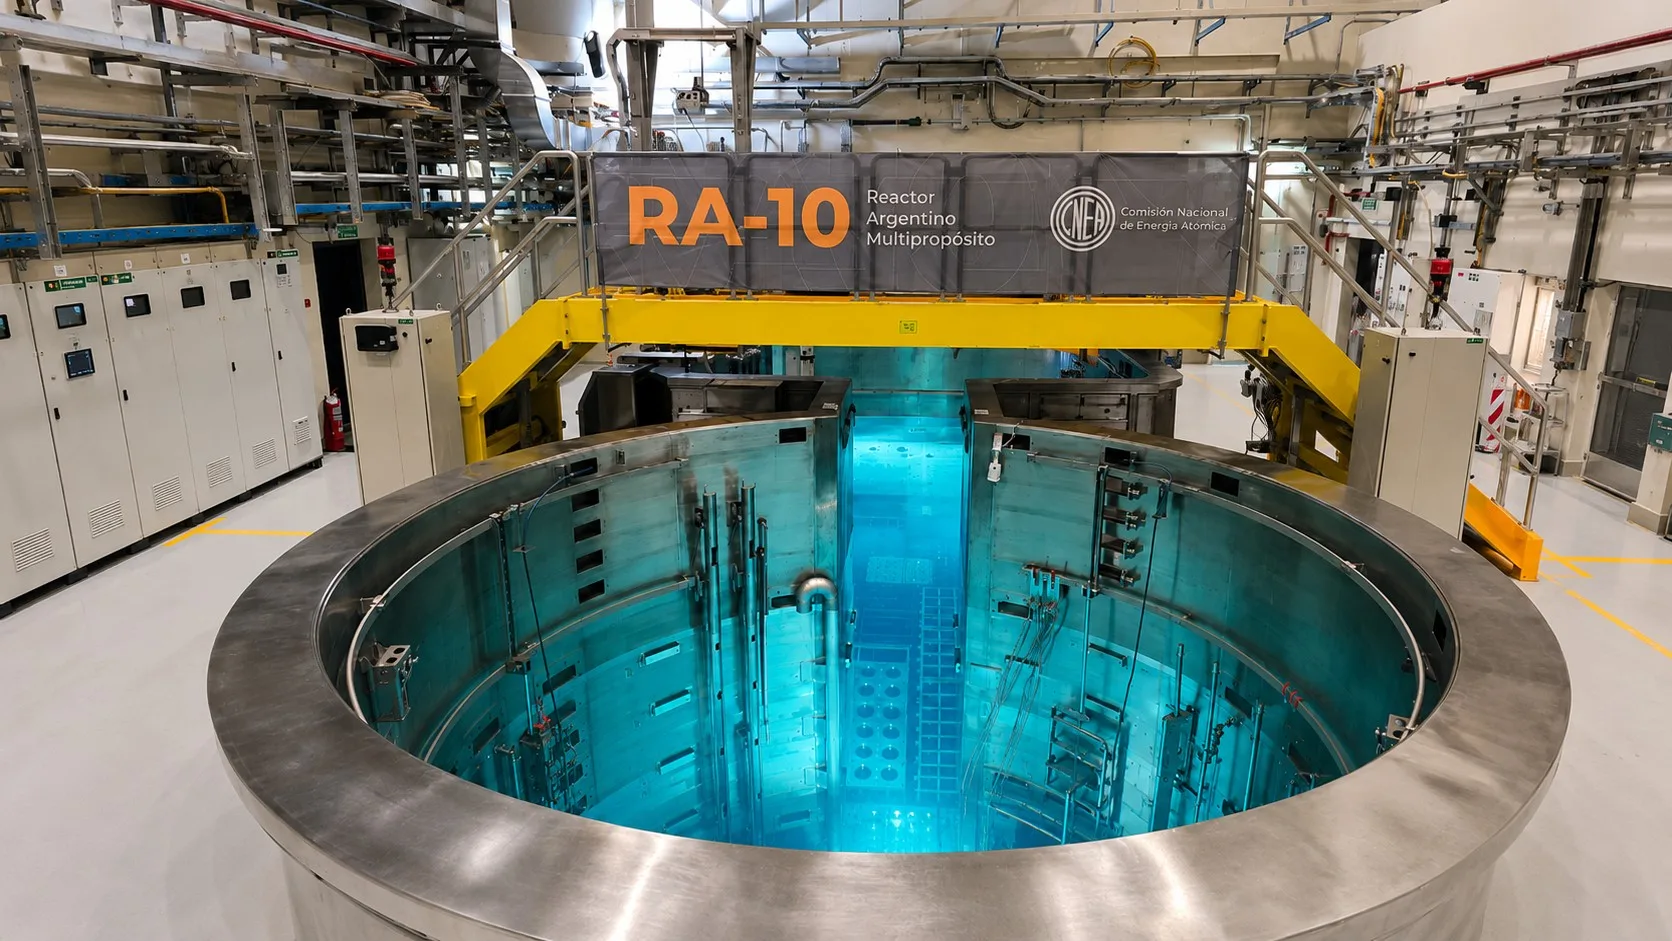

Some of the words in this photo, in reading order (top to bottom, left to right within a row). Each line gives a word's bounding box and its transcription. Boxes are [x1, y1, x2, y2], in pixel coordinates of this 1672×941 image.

[866, 189, 935, 204] Reactor
[628, 185, 851, 249] RA-10
[1120, 206, 1174, 217] Comisión
[1177, 206, 1229, 217] Nacional
[866, 211, 957, 229] Argentino
[1119, 220, 1134, 230] de
[866, 231, 996, 250] Multipropósito
